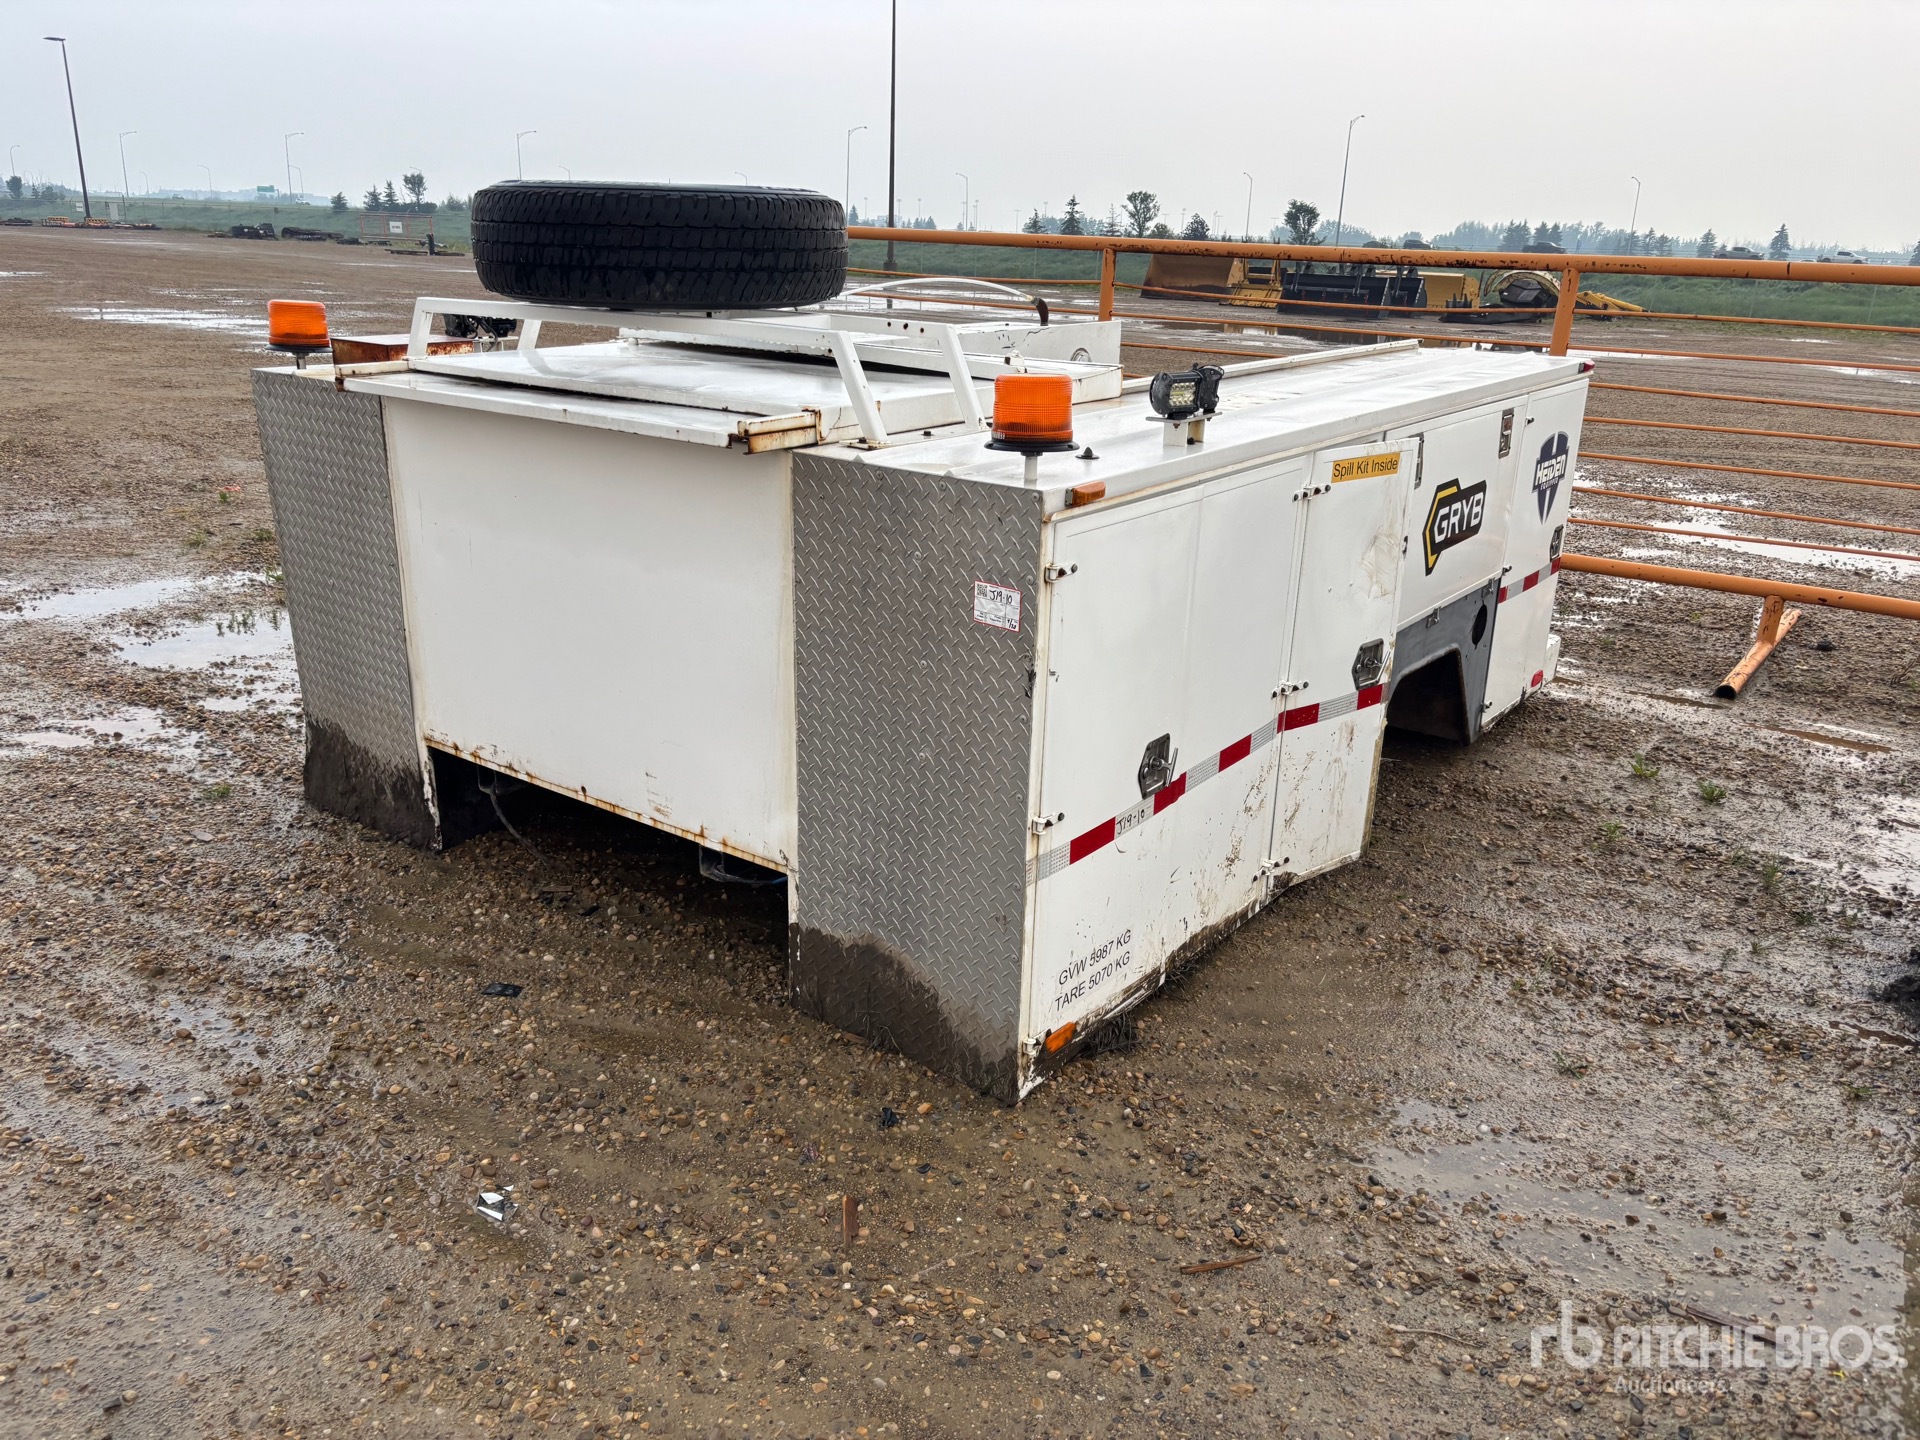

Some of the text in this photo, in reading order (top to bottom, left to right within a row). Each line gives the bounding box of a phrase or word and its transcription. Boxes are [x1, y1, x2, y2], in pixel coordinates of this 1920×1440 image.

[1333, 458, 1398, 480] Spill Kit Inside
[1434, 492, 1483, 543] GRYB
[1054, 950, 1130, 1012] TARE 5070 KG
[1058, 928, 1131, 985] GVW 5987 KG
